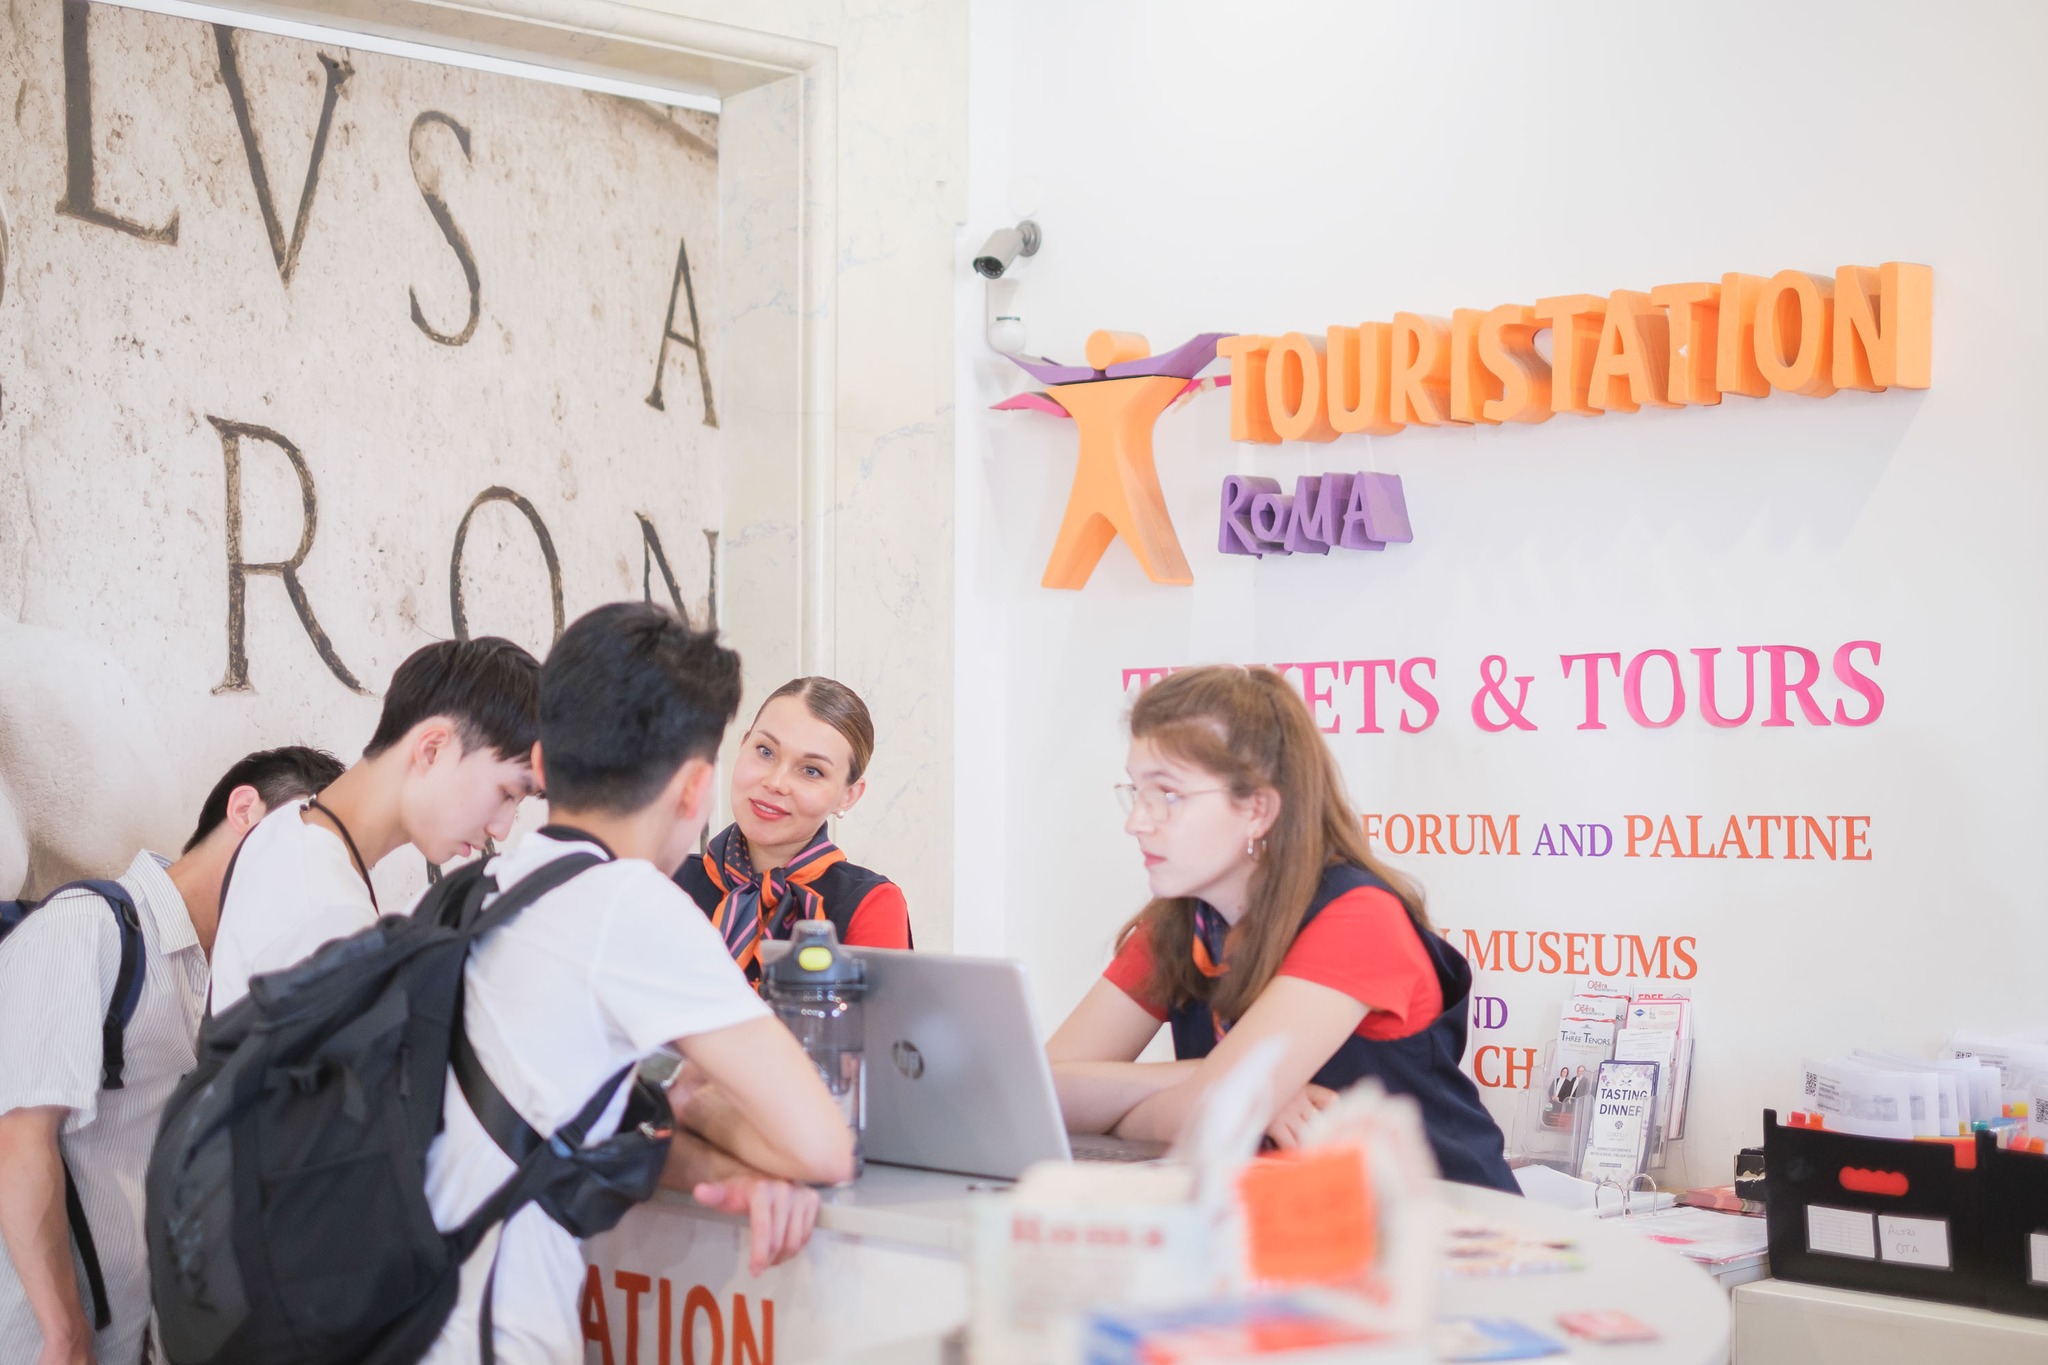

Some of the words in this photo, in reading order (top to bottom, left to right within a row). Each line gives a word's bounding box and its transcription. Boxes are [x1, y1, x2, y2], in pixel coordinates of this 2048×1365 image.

[1216, 261, 1933, 445] TOURISTATION
[1217, 471, 1413, 559] ROMA
[1471, 654, 1538, 733] &
[1560, 640, 1885, 729] TOURS
[1361, 813, 1520, 856] FORUM
[1532, 823, 1613, 857] AND
[1623, 815, 1873, 861] PALATINE
[1462, 928, 1699, 980] MUSEUMS
[1583, 1032, 1611, 1046] TENORS
[1601, 1088, 1648, 1101] TASTING
